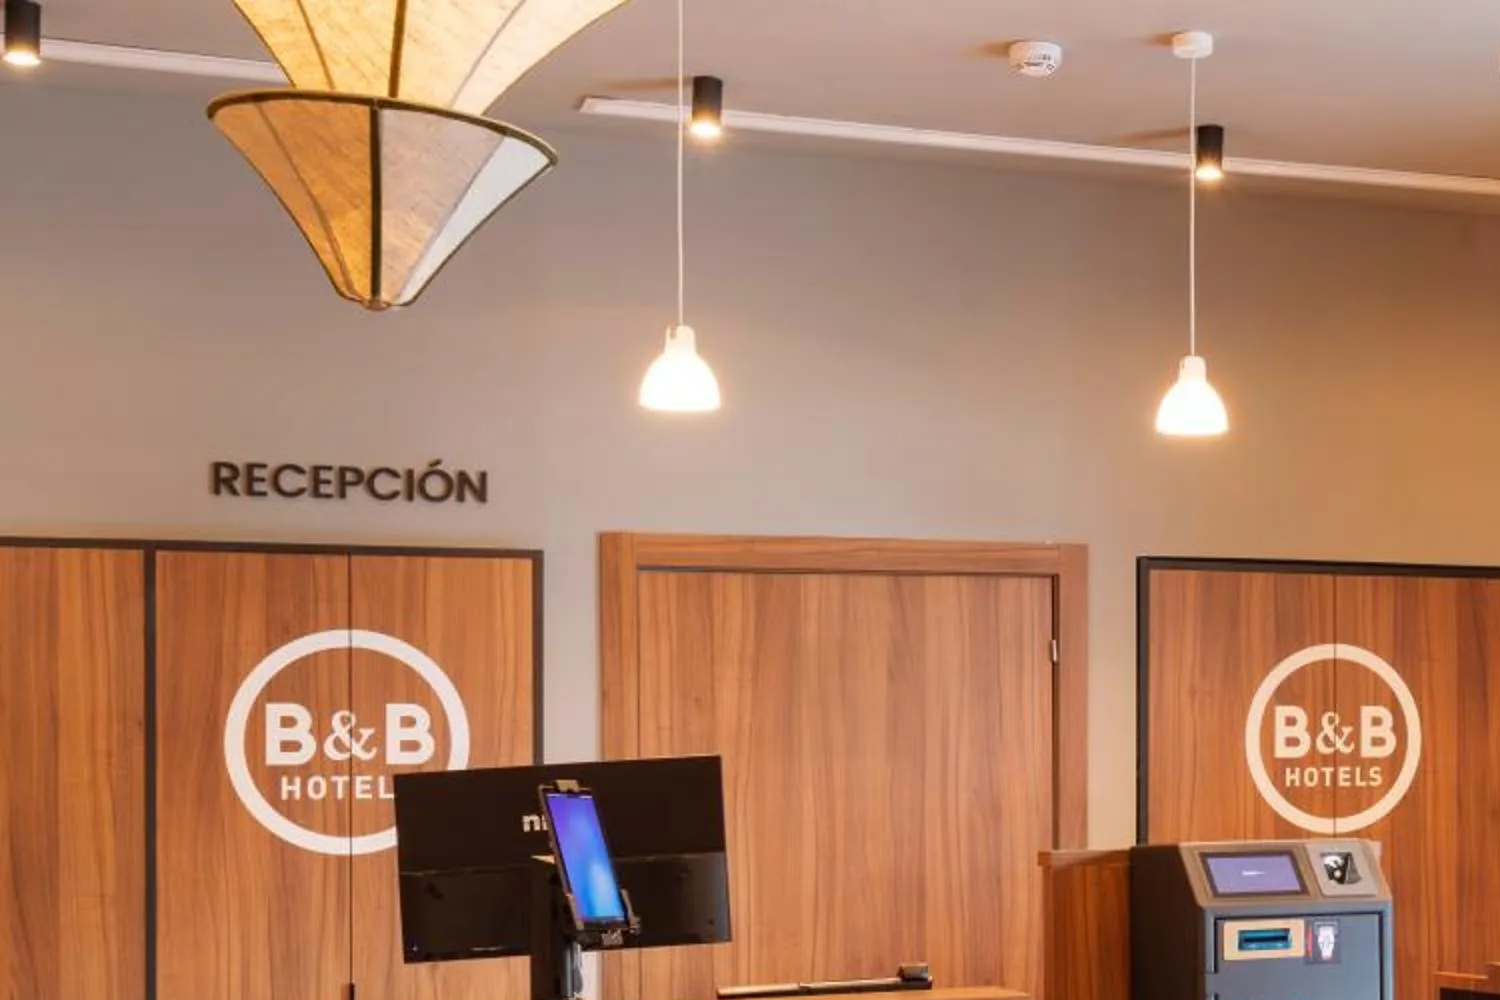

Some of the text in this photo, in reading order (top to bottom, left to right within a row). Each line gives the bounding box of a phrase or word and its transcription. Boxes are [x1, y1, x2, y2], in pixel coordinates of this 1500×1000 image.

[210, 458, 488, 504] RECEPCIÓN
[265, 703, 436, 766] B&B
[1274, 705, 1397, 759] B&B
[280, 774, 395, 801] HOTEL
[1284, 766, 1383, 788] HOTELS
